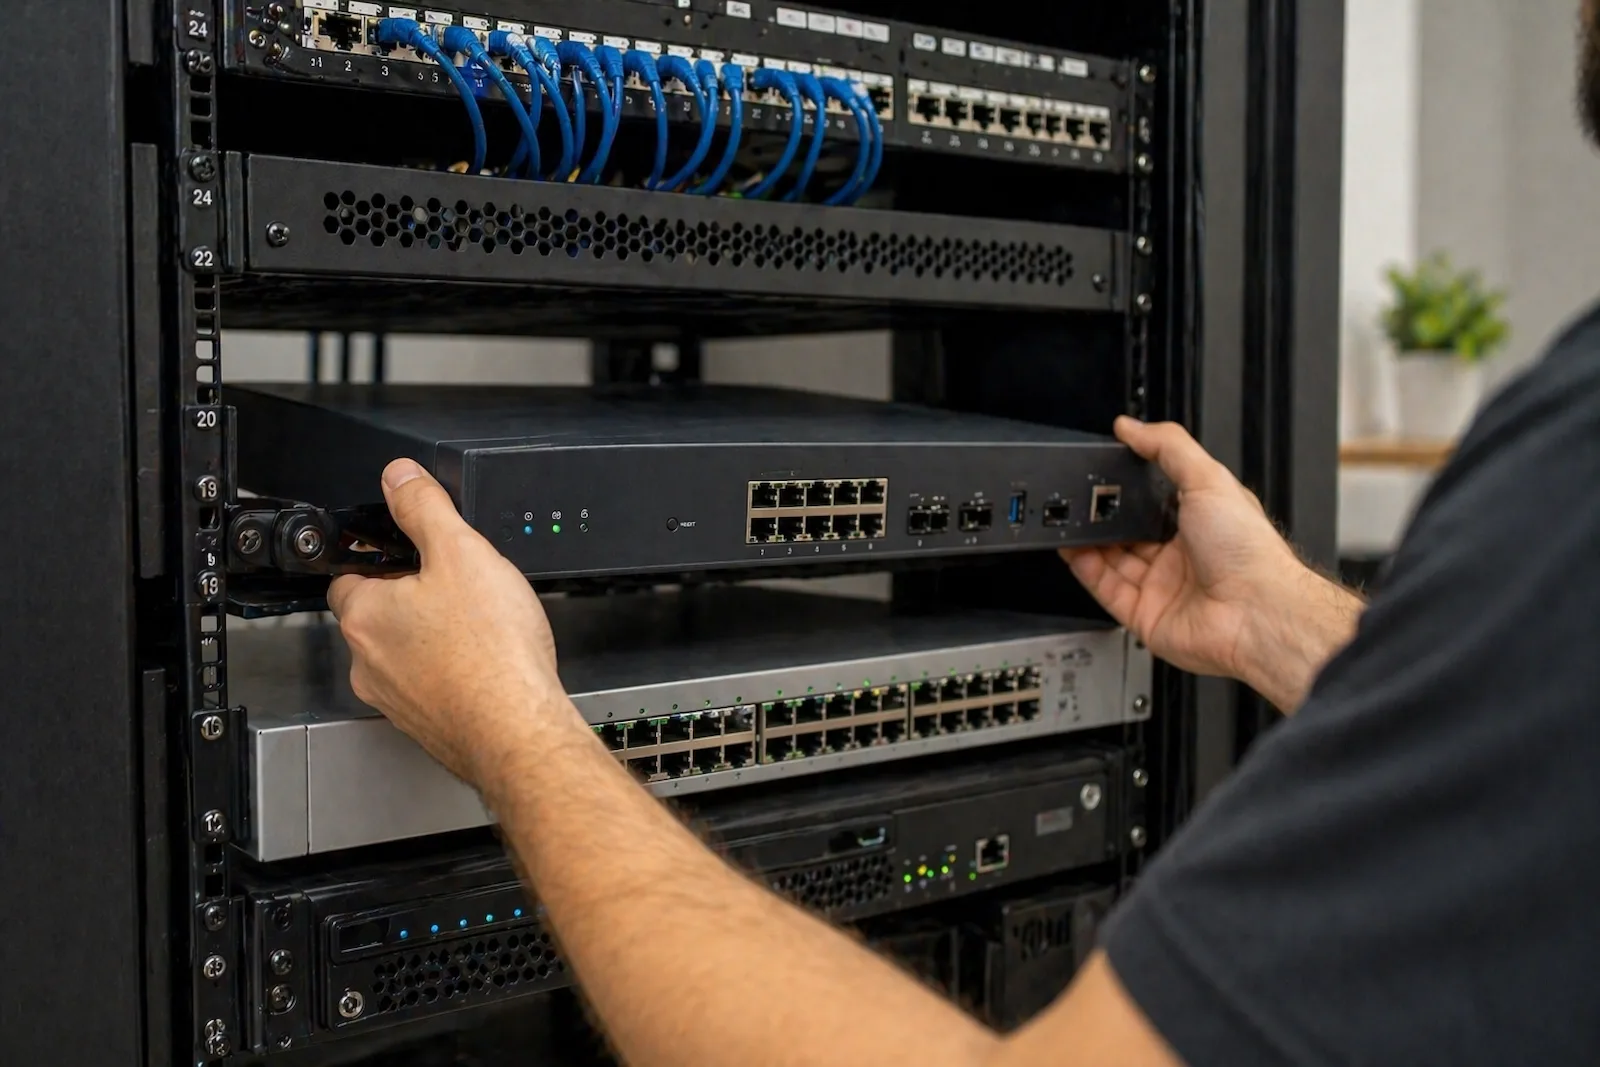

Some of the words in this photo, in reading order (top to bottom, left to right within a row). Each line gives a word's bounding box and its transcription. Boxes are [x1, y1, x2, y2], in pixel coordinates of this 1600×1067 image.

[188, 20, 208, 37] 24
[344, 60, 352, 72] 2
[381, 65, 389, 76] 3
[193, 188, 213, 205] 24
[194, 250, 214, 266] 22
[197, 411, 217, 427] 20
[200, 480, 218, 498] 19
